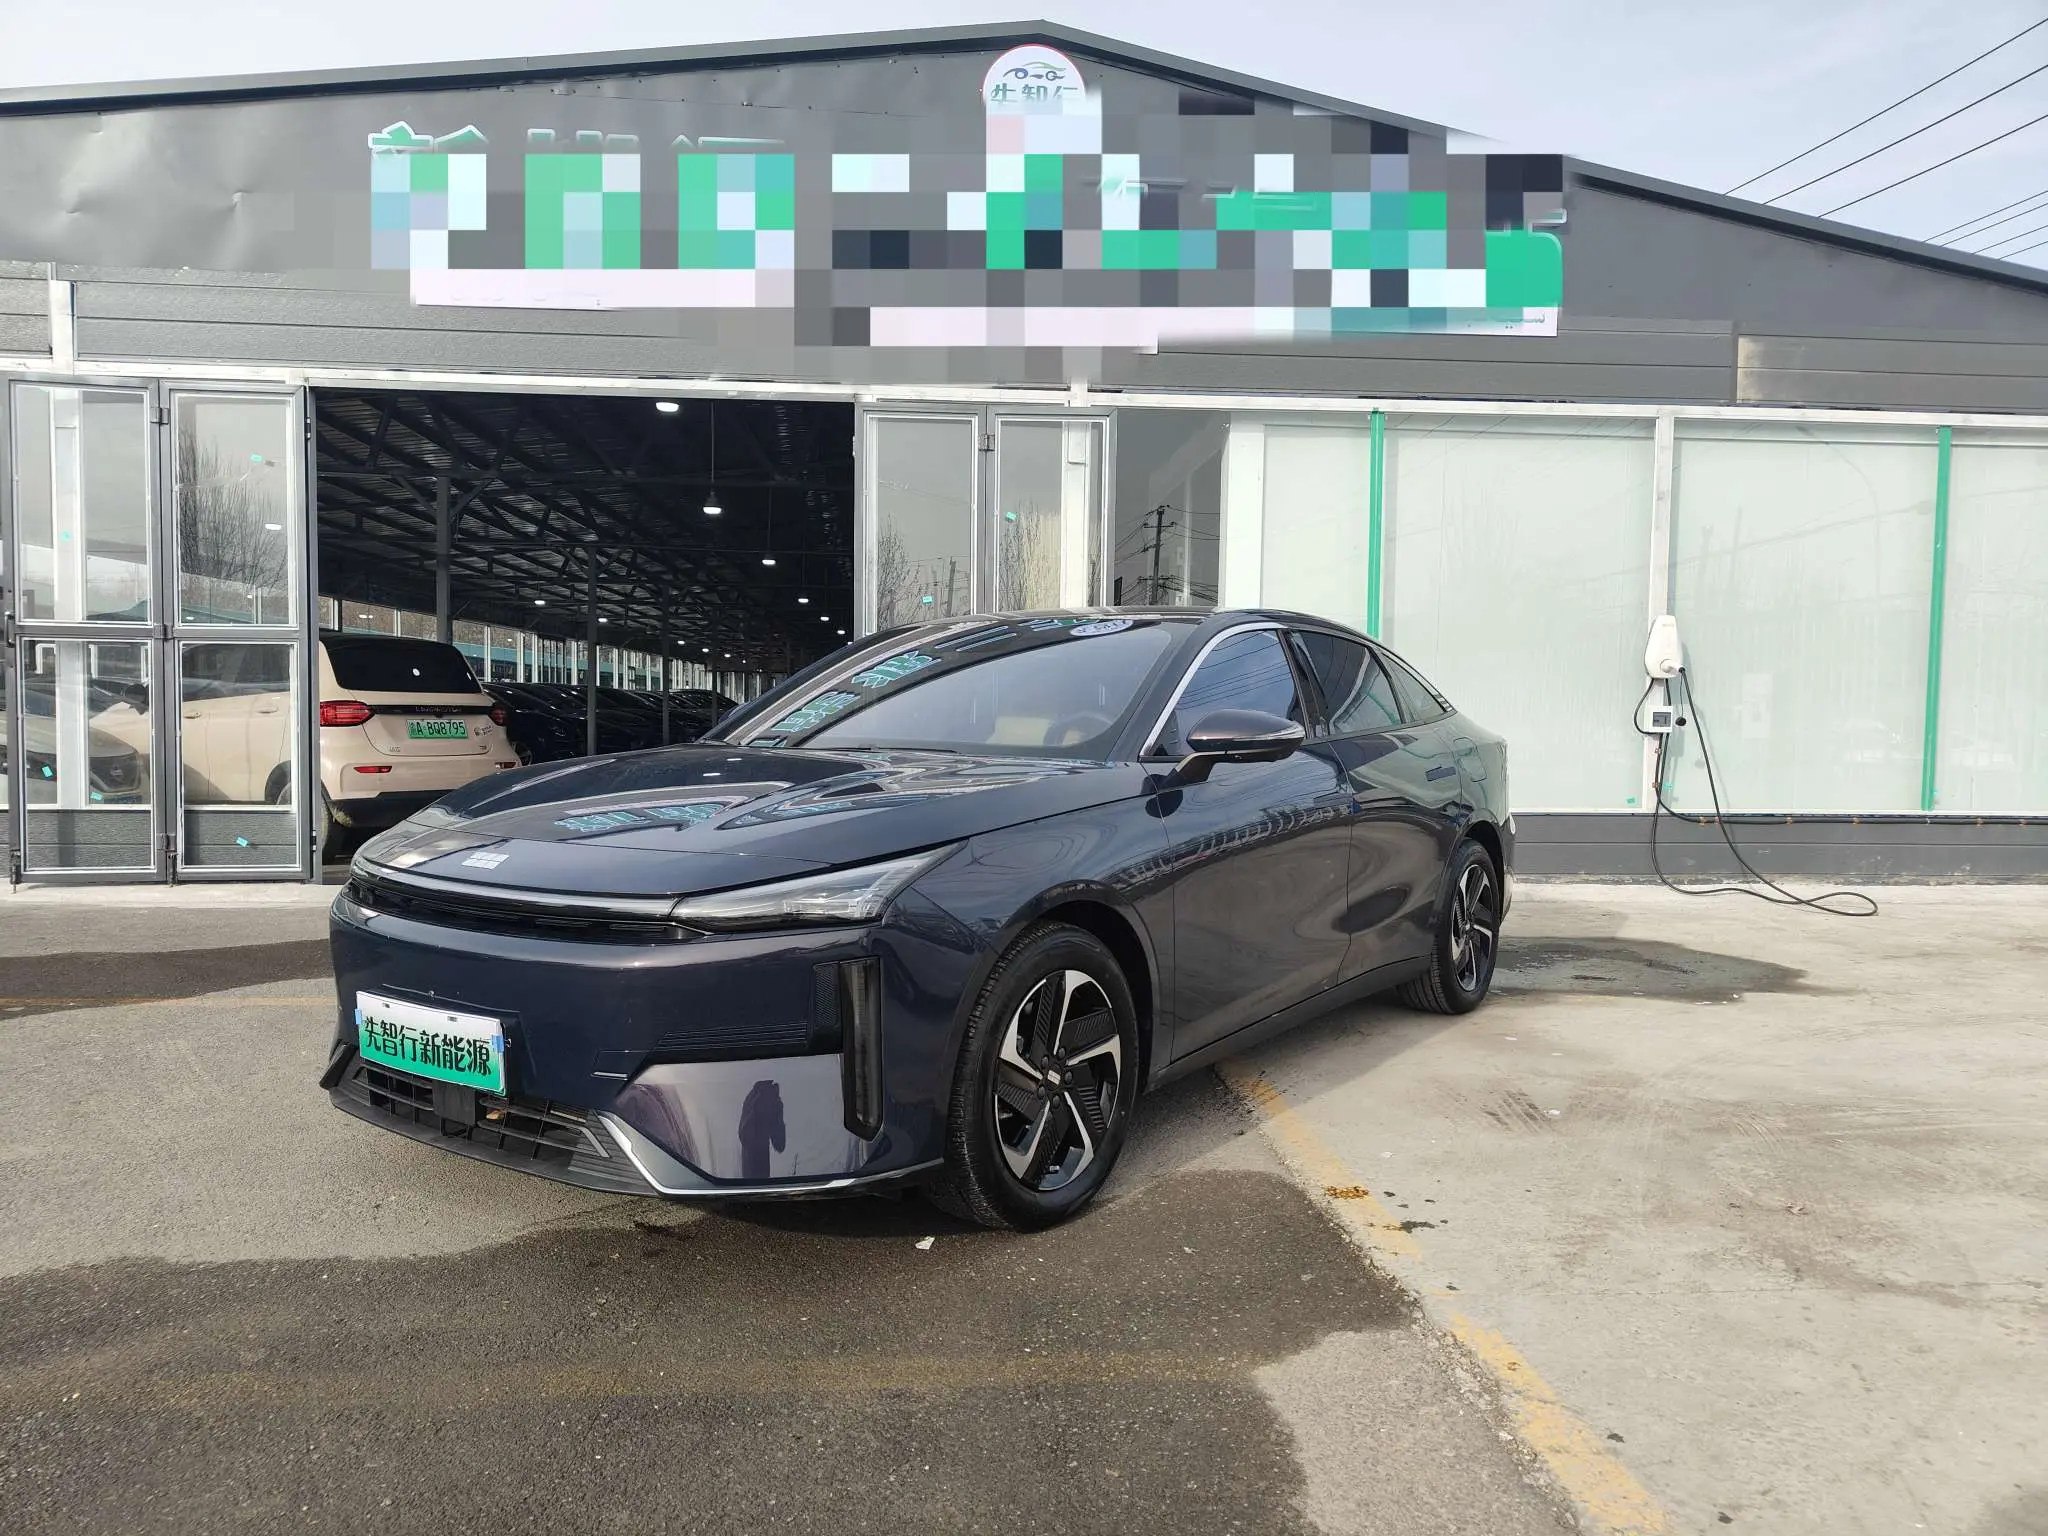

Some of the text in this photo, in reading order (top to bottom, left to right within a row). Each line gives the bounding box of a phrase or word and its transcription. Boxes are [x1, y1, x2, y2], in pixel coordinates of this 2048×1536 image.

[364, 1015, 492, 1077] 先智行新能源
